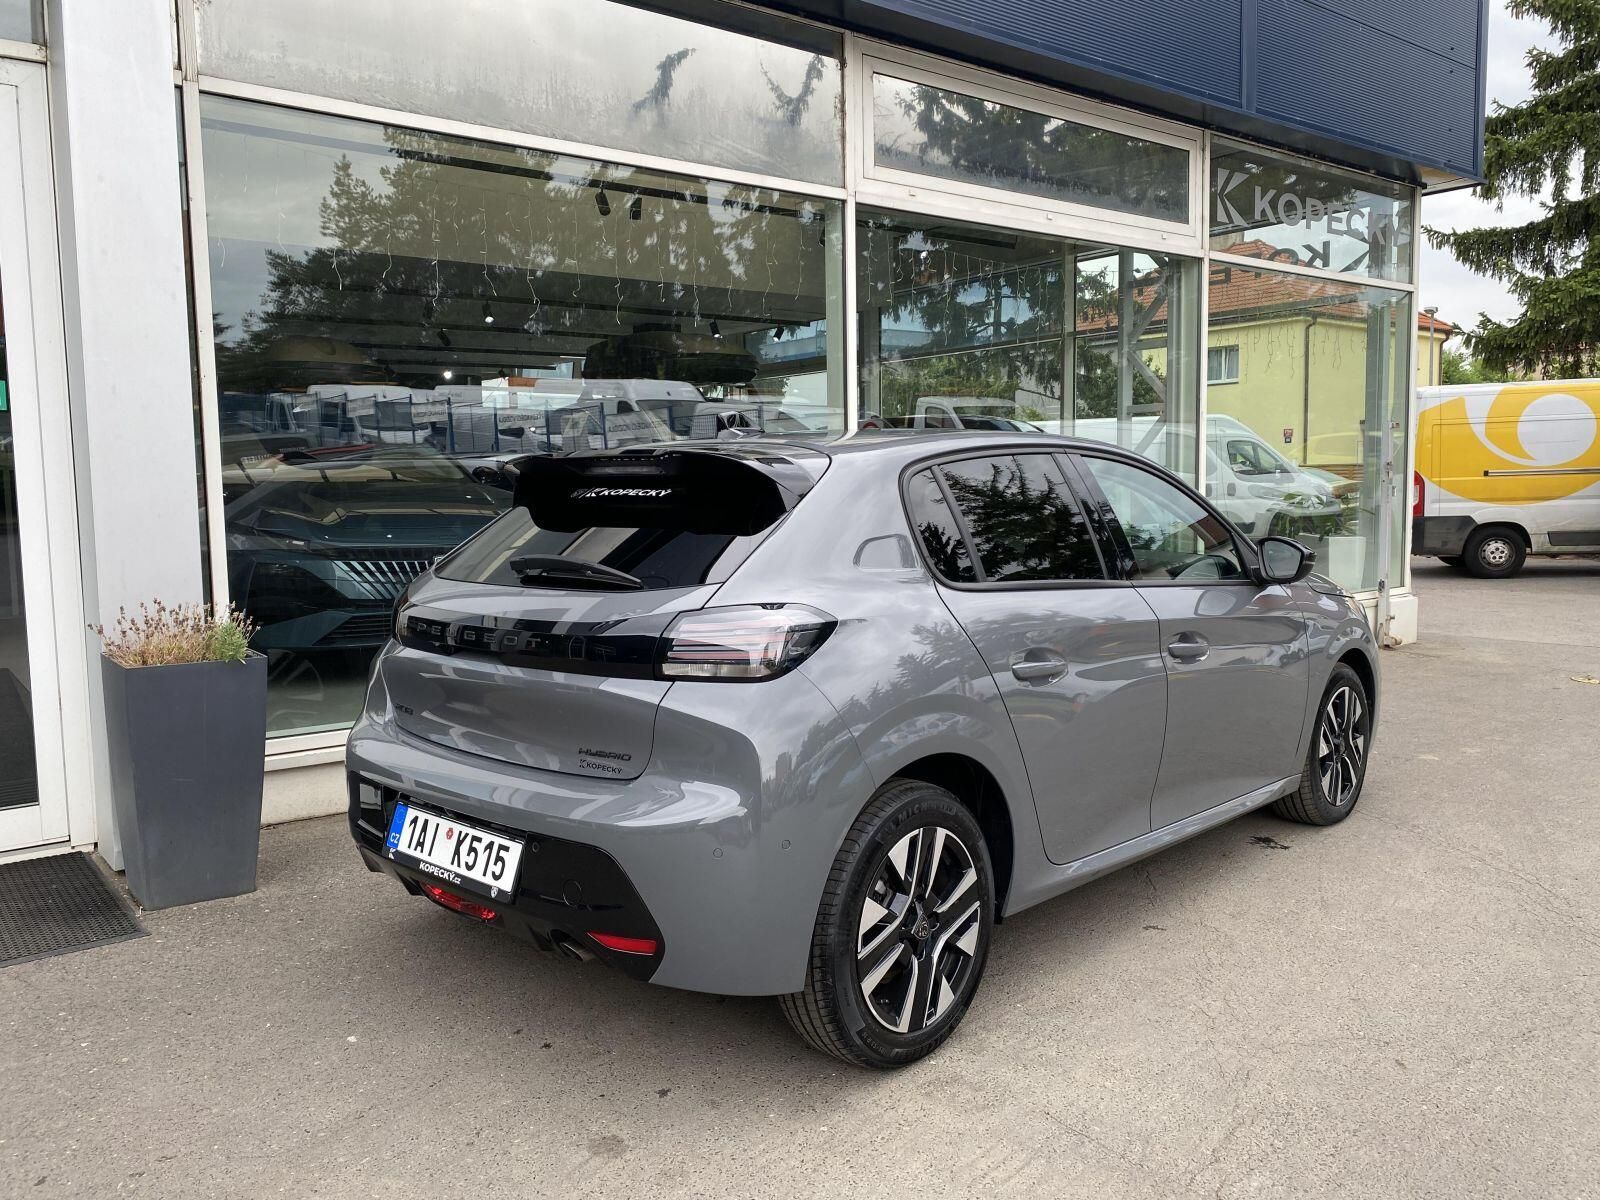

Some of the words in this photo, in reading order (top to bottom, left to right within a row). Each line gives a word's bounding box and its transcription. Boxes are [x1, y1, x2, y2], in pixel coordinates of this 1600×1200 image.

[390, 832, 400, 844] CZ
[407, 815, 440, 857] 1AI
[450, 830, 511, 882] K515
